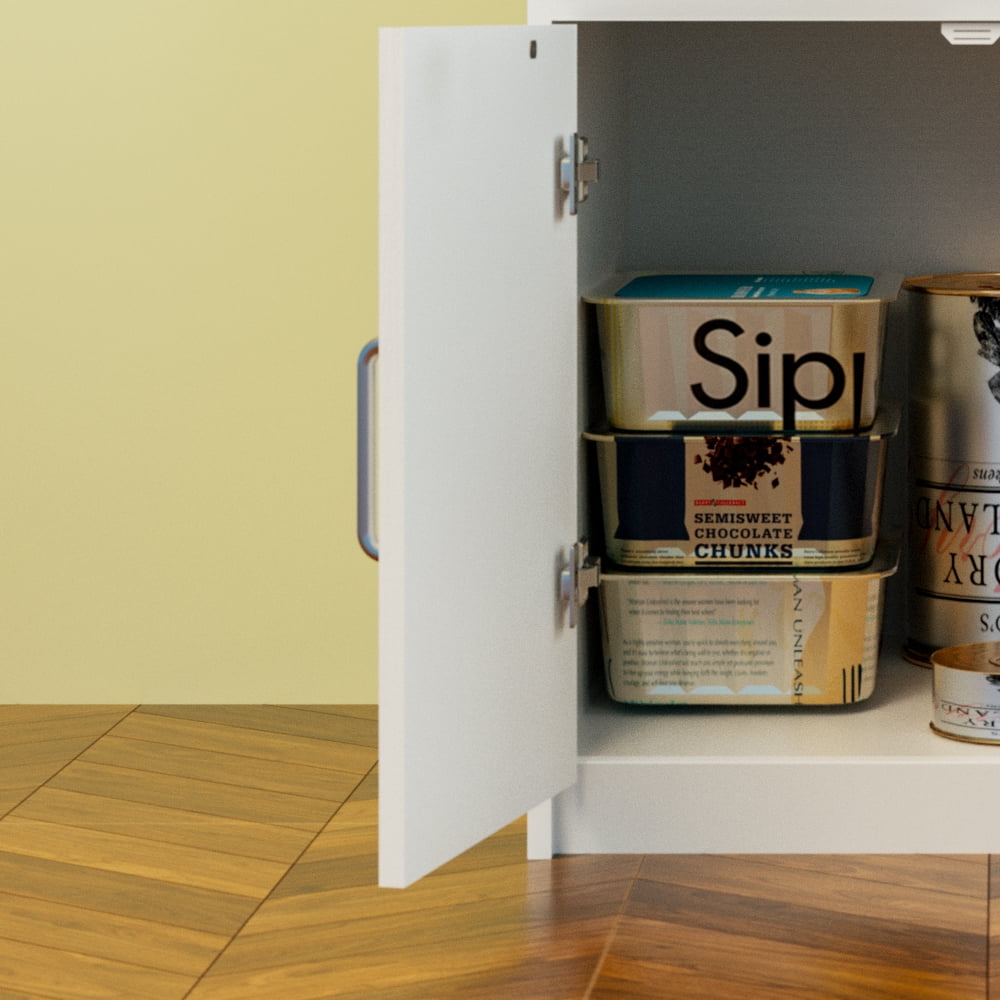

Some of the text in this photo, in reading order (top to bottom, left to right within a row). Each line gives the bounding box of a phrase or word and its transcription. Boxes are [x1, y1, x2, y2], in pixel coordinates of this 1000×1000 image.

[694, 512, 793, 524] SEMISWEET
[694, 528, 793, 539] CHOCOLATE
[694, 543, 793, 560] CHUNKS
